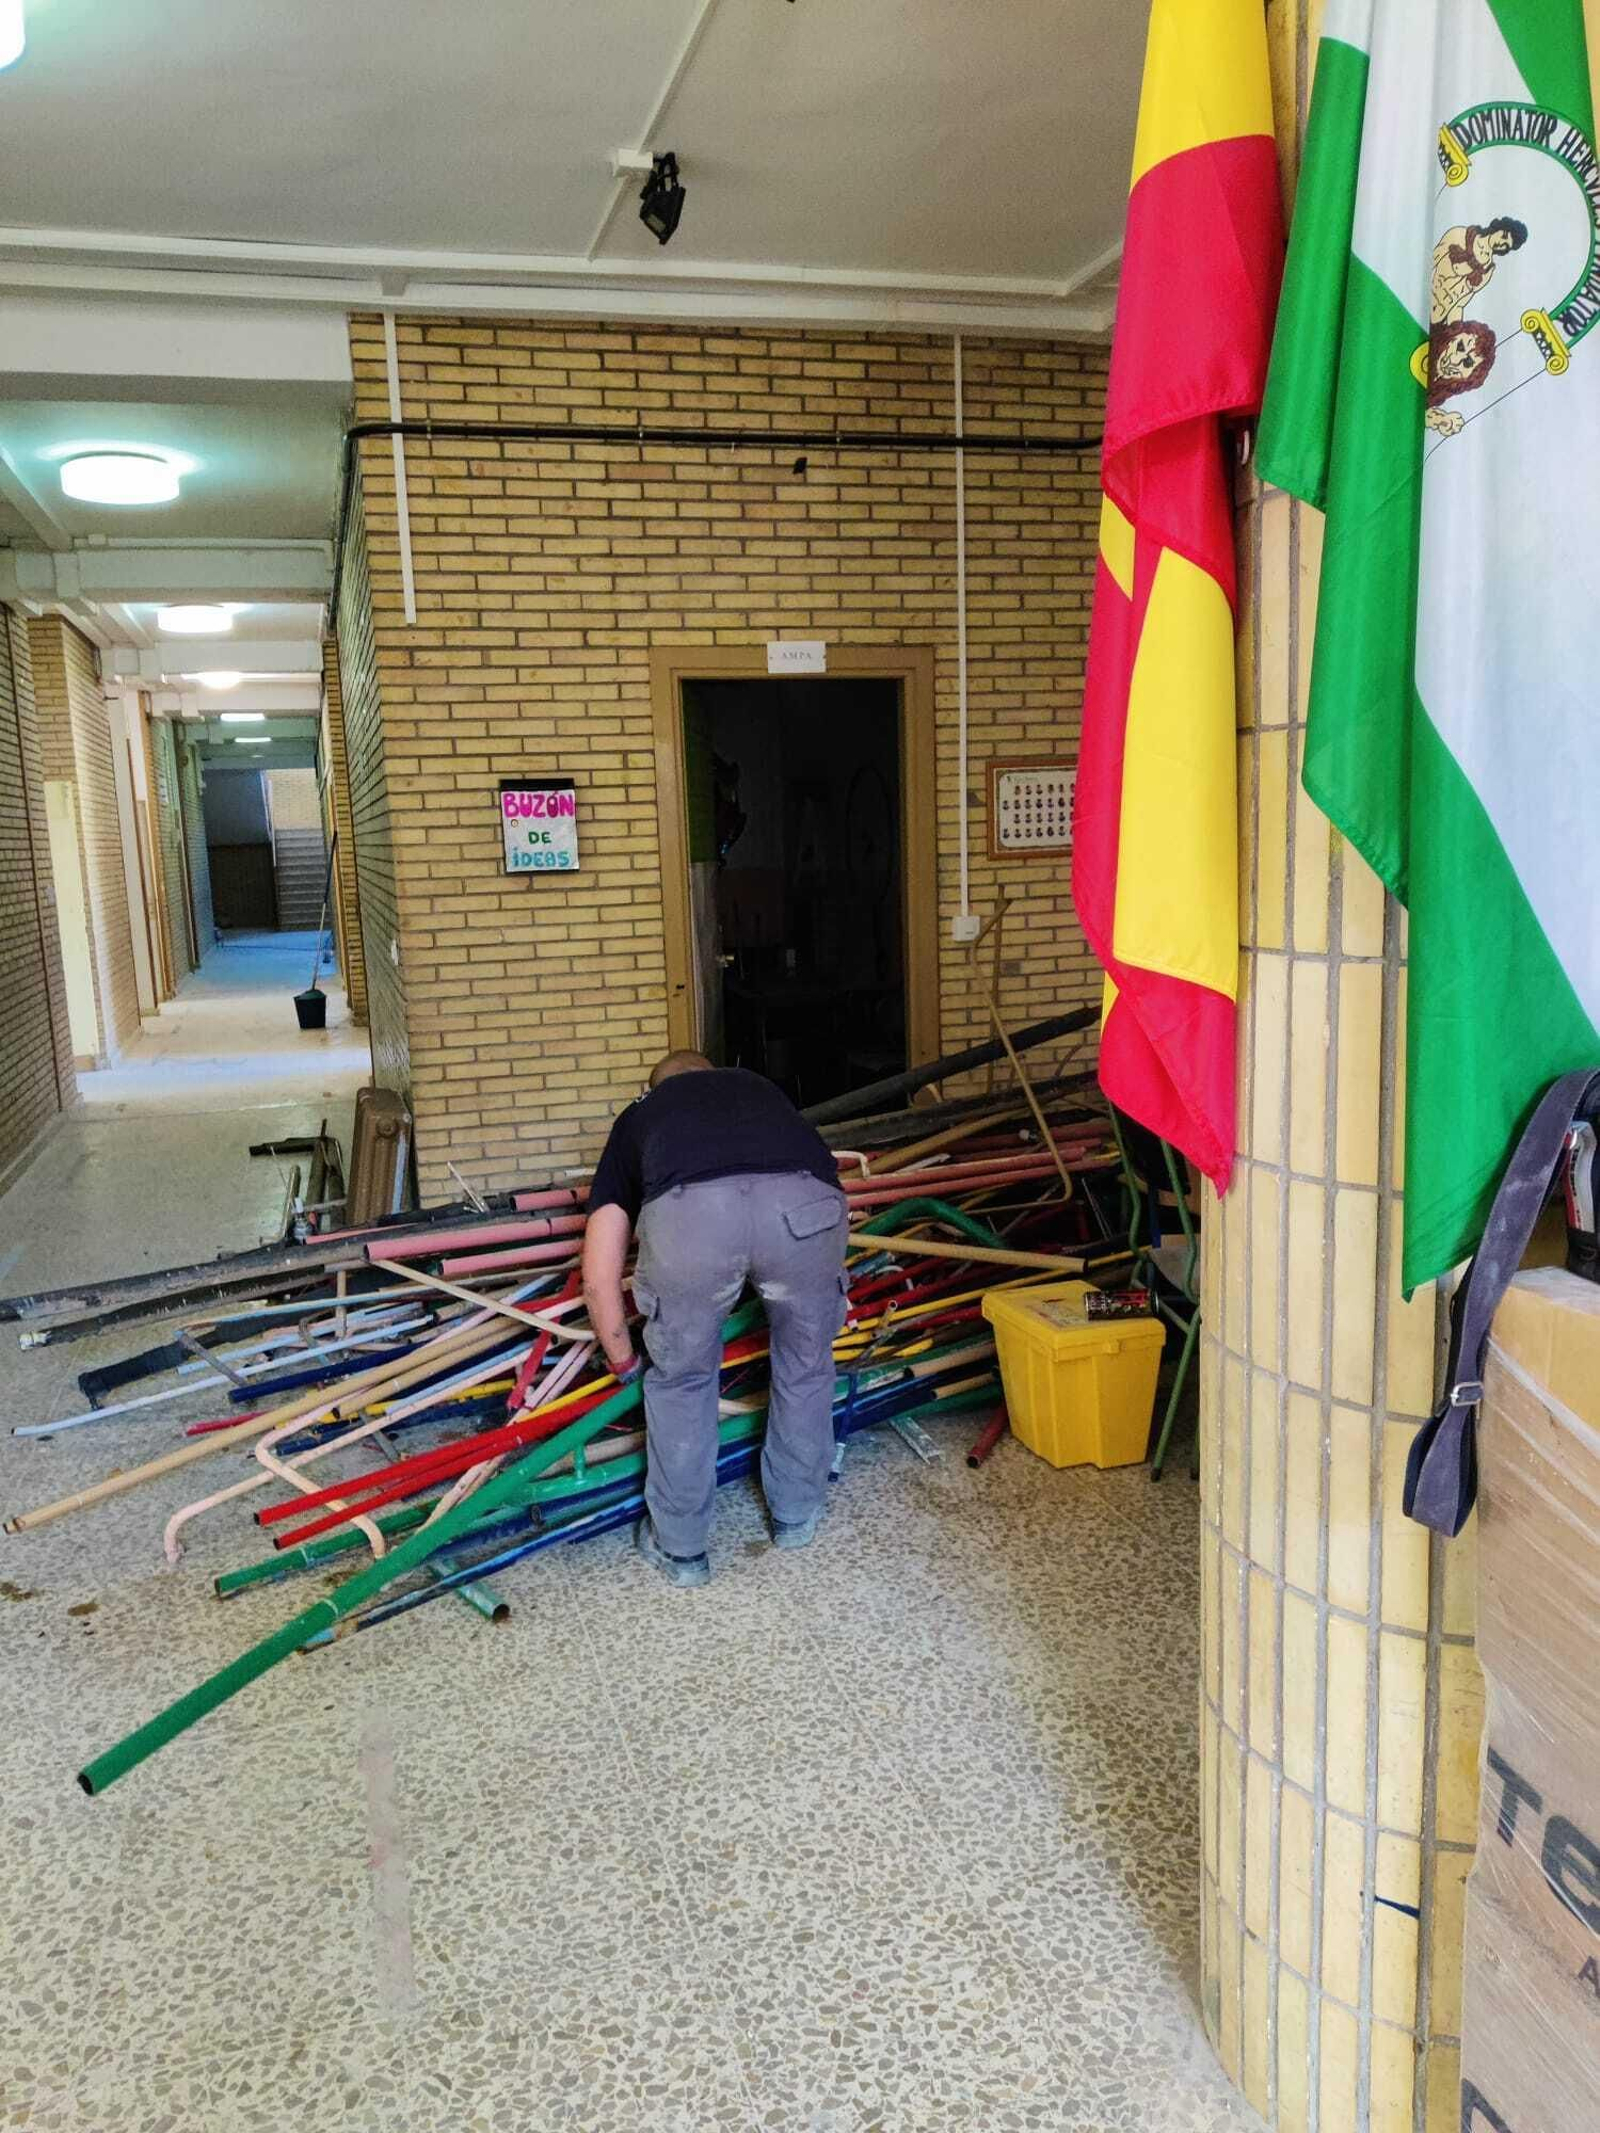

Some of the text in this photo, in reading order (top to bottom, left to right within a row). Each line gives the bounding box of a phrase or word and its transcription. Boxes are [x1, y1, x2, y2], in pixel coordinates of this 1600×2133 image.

[1451, 107, 1558, 150] DOMINATOR
[503, 790, 574, 818] BUZÓN
[528, 831, 551, 844] DE
